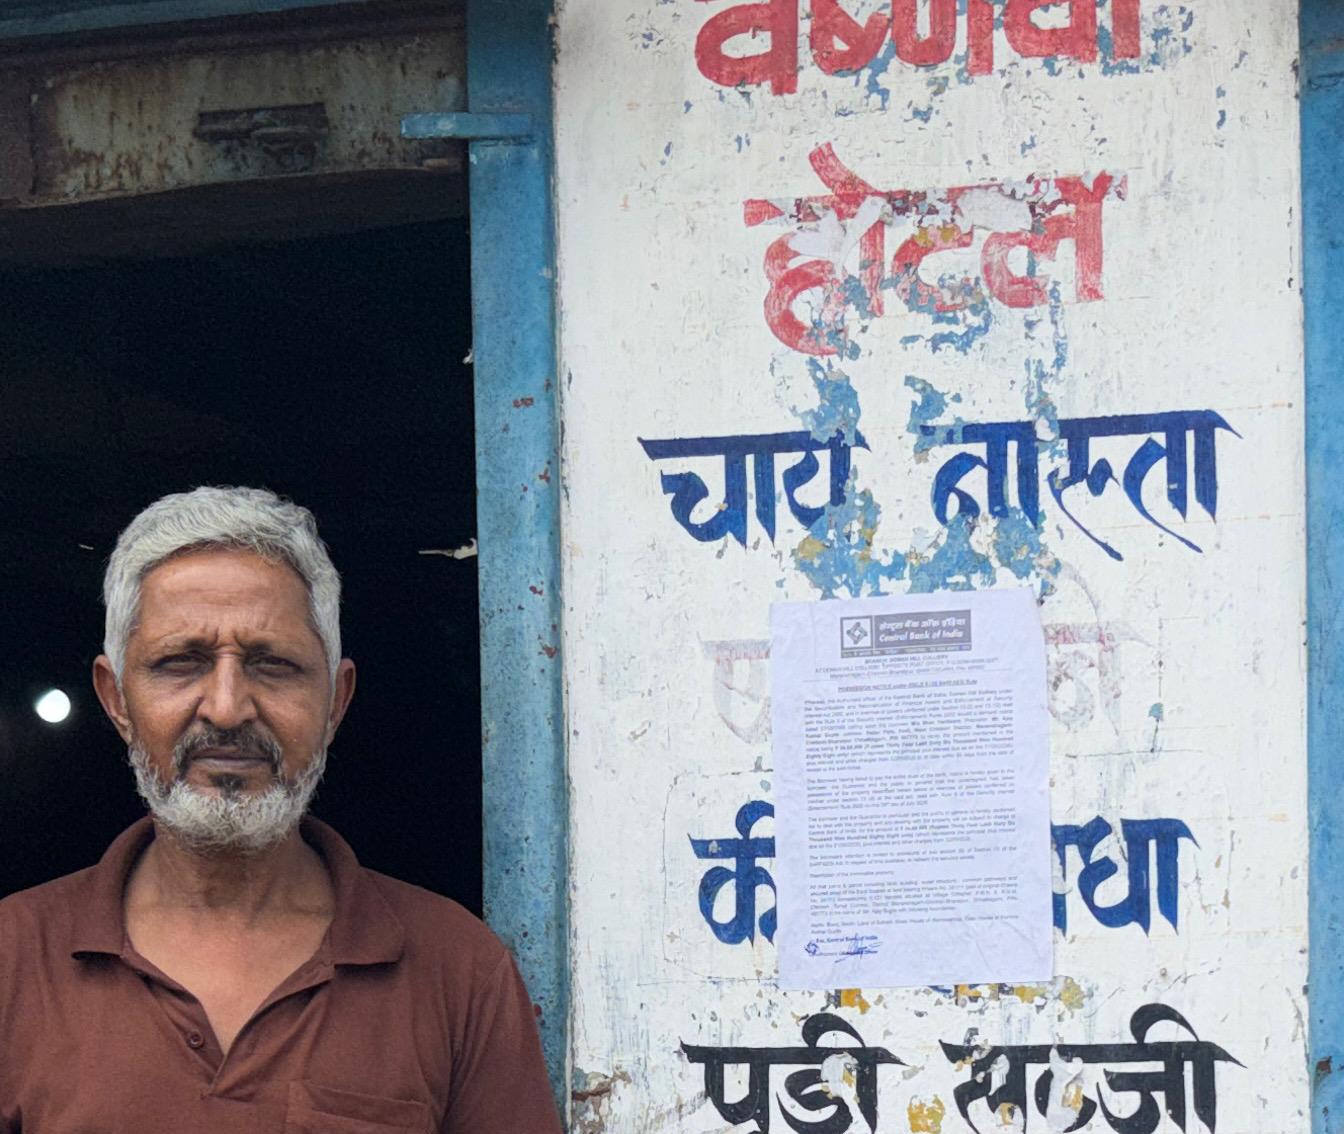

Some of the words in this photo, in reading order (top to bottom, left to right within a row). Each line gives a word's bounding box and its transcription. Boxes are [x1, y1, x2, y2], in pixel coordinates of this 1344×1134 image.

[744, 142, 1128, 356] होटल
[637, 429, 872, 549] चाय
[879, 631, 907, 642] Central
[909, 629, 930, 640] Bank
[932, 628, 941, 640] of
[942, 628, 964, 639] India
